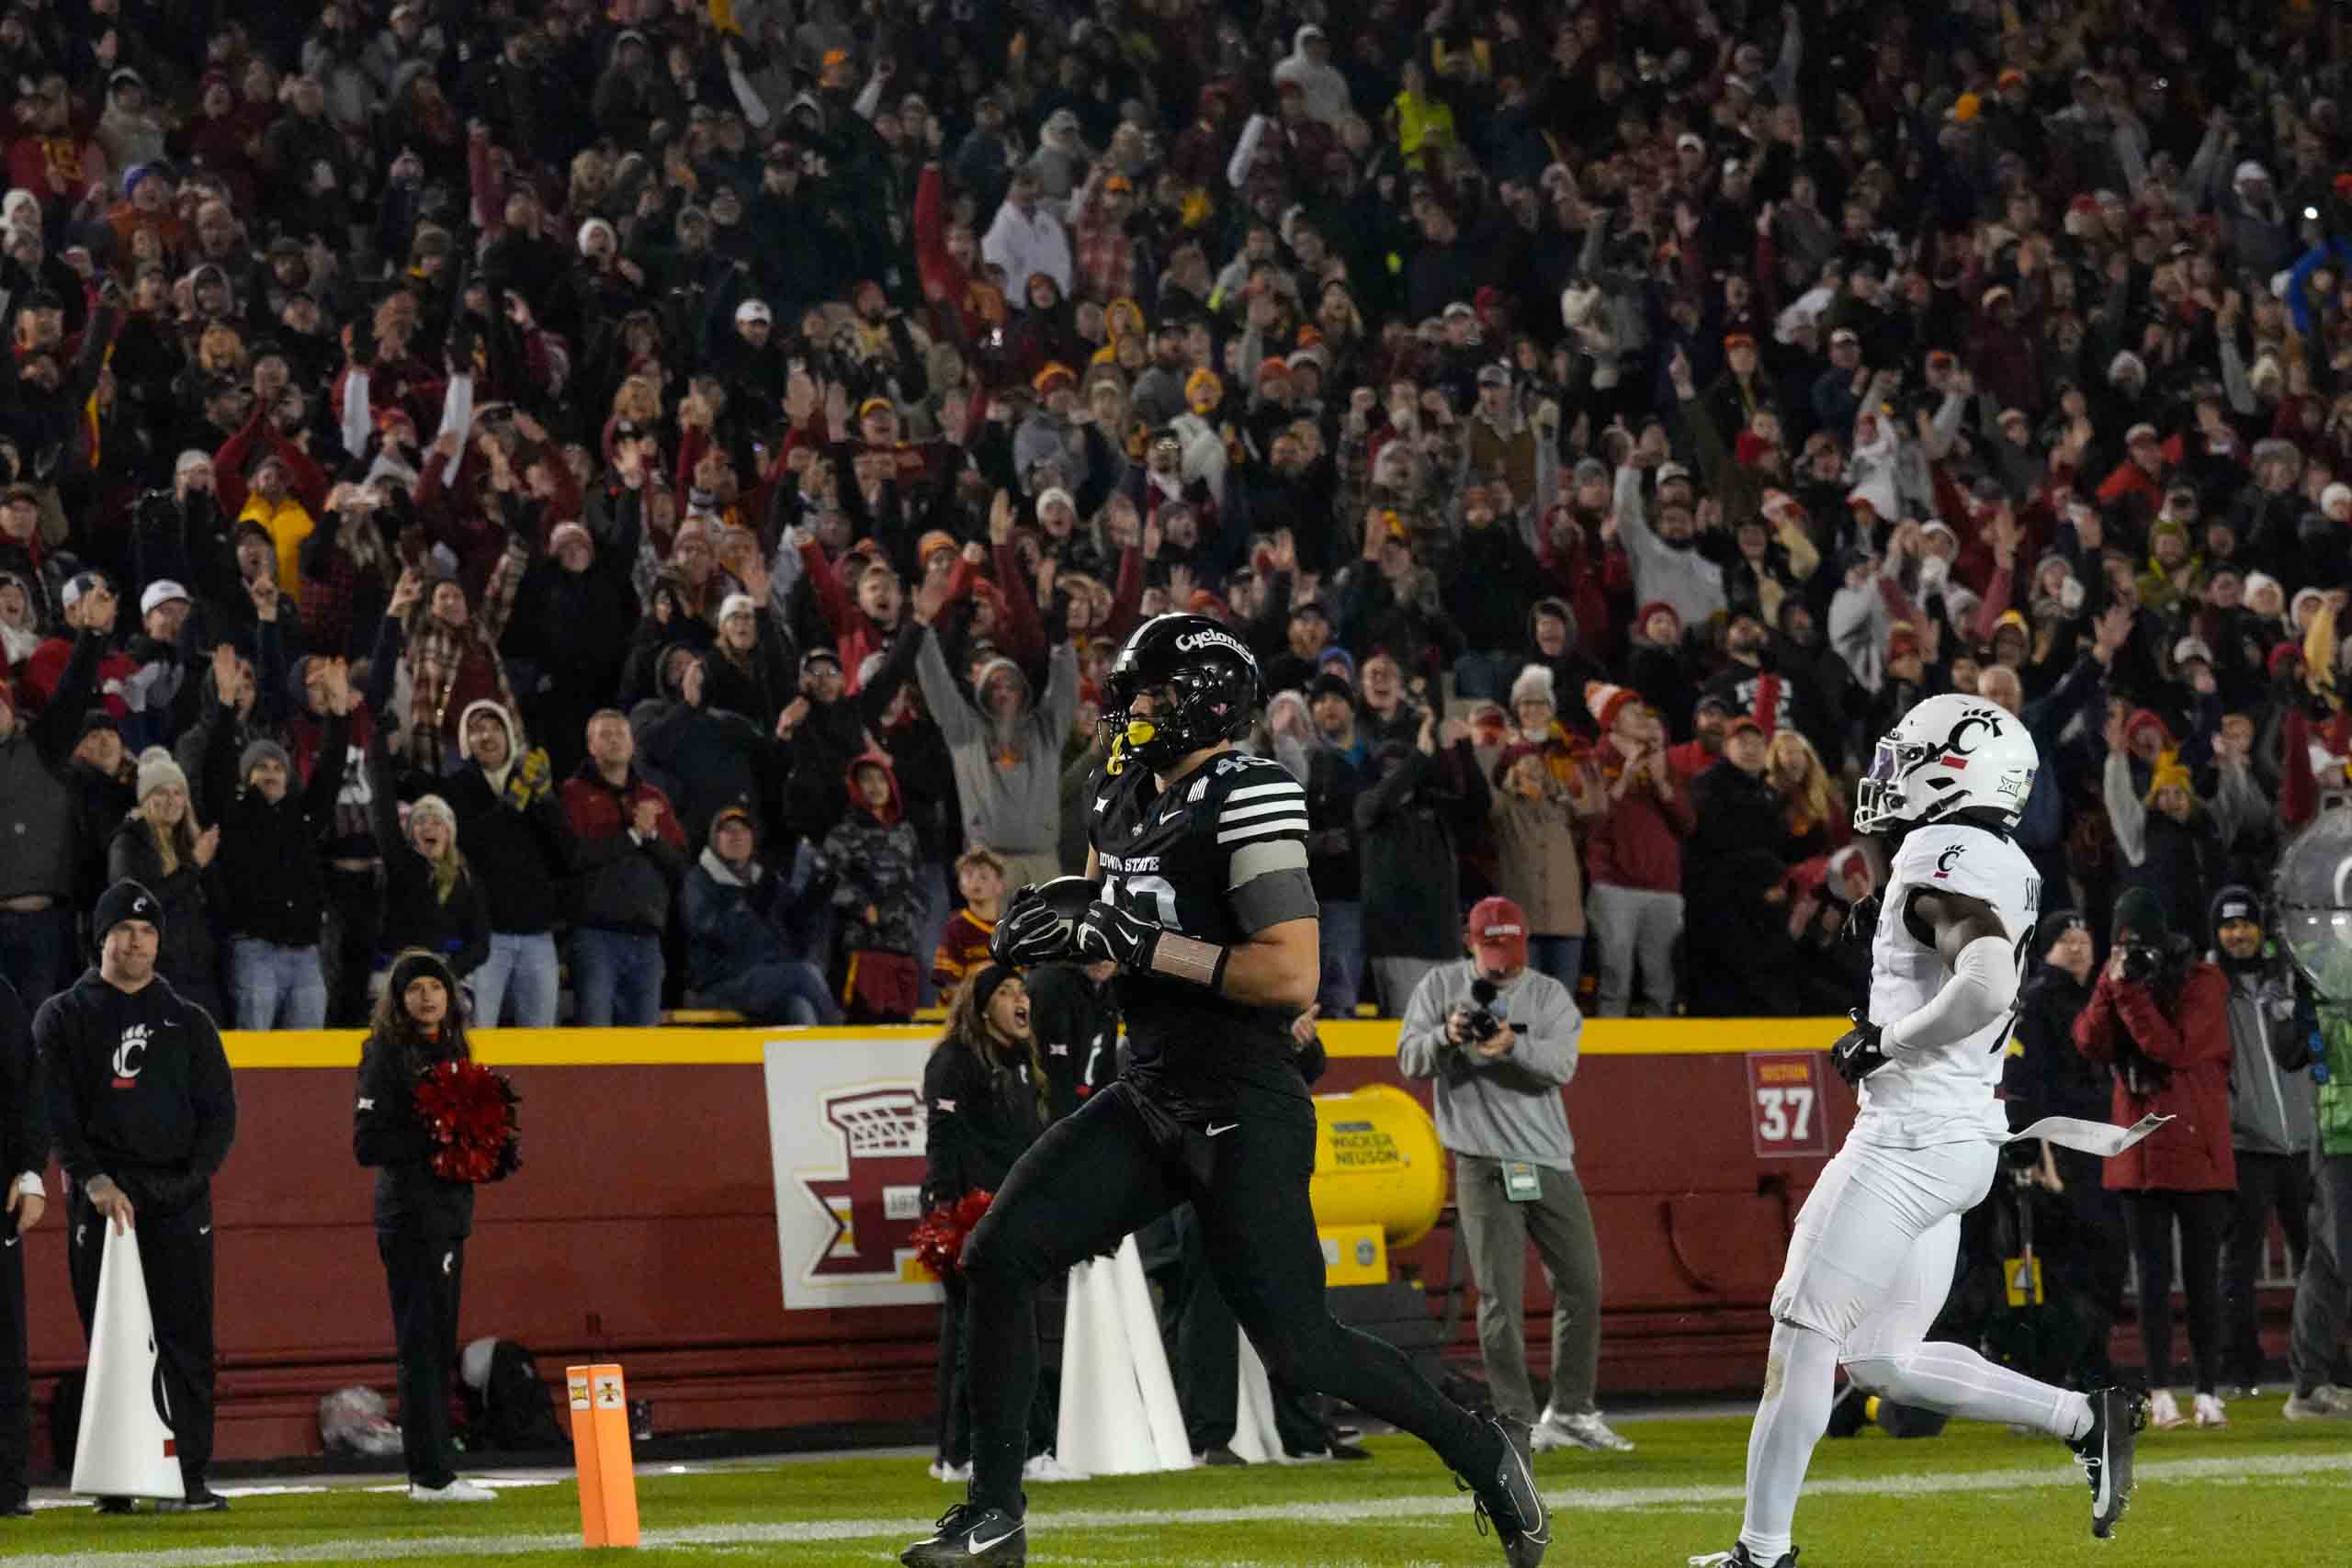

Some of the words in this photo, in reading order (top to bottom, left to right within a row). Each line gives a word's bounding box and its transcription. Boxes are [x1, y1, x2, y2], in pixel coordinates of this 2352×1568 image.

[1100, 852, 1123, 871] IOWA
[1125, 856, 1160, 873] STATE
[1757, 1088, 1814, 1140] 37
